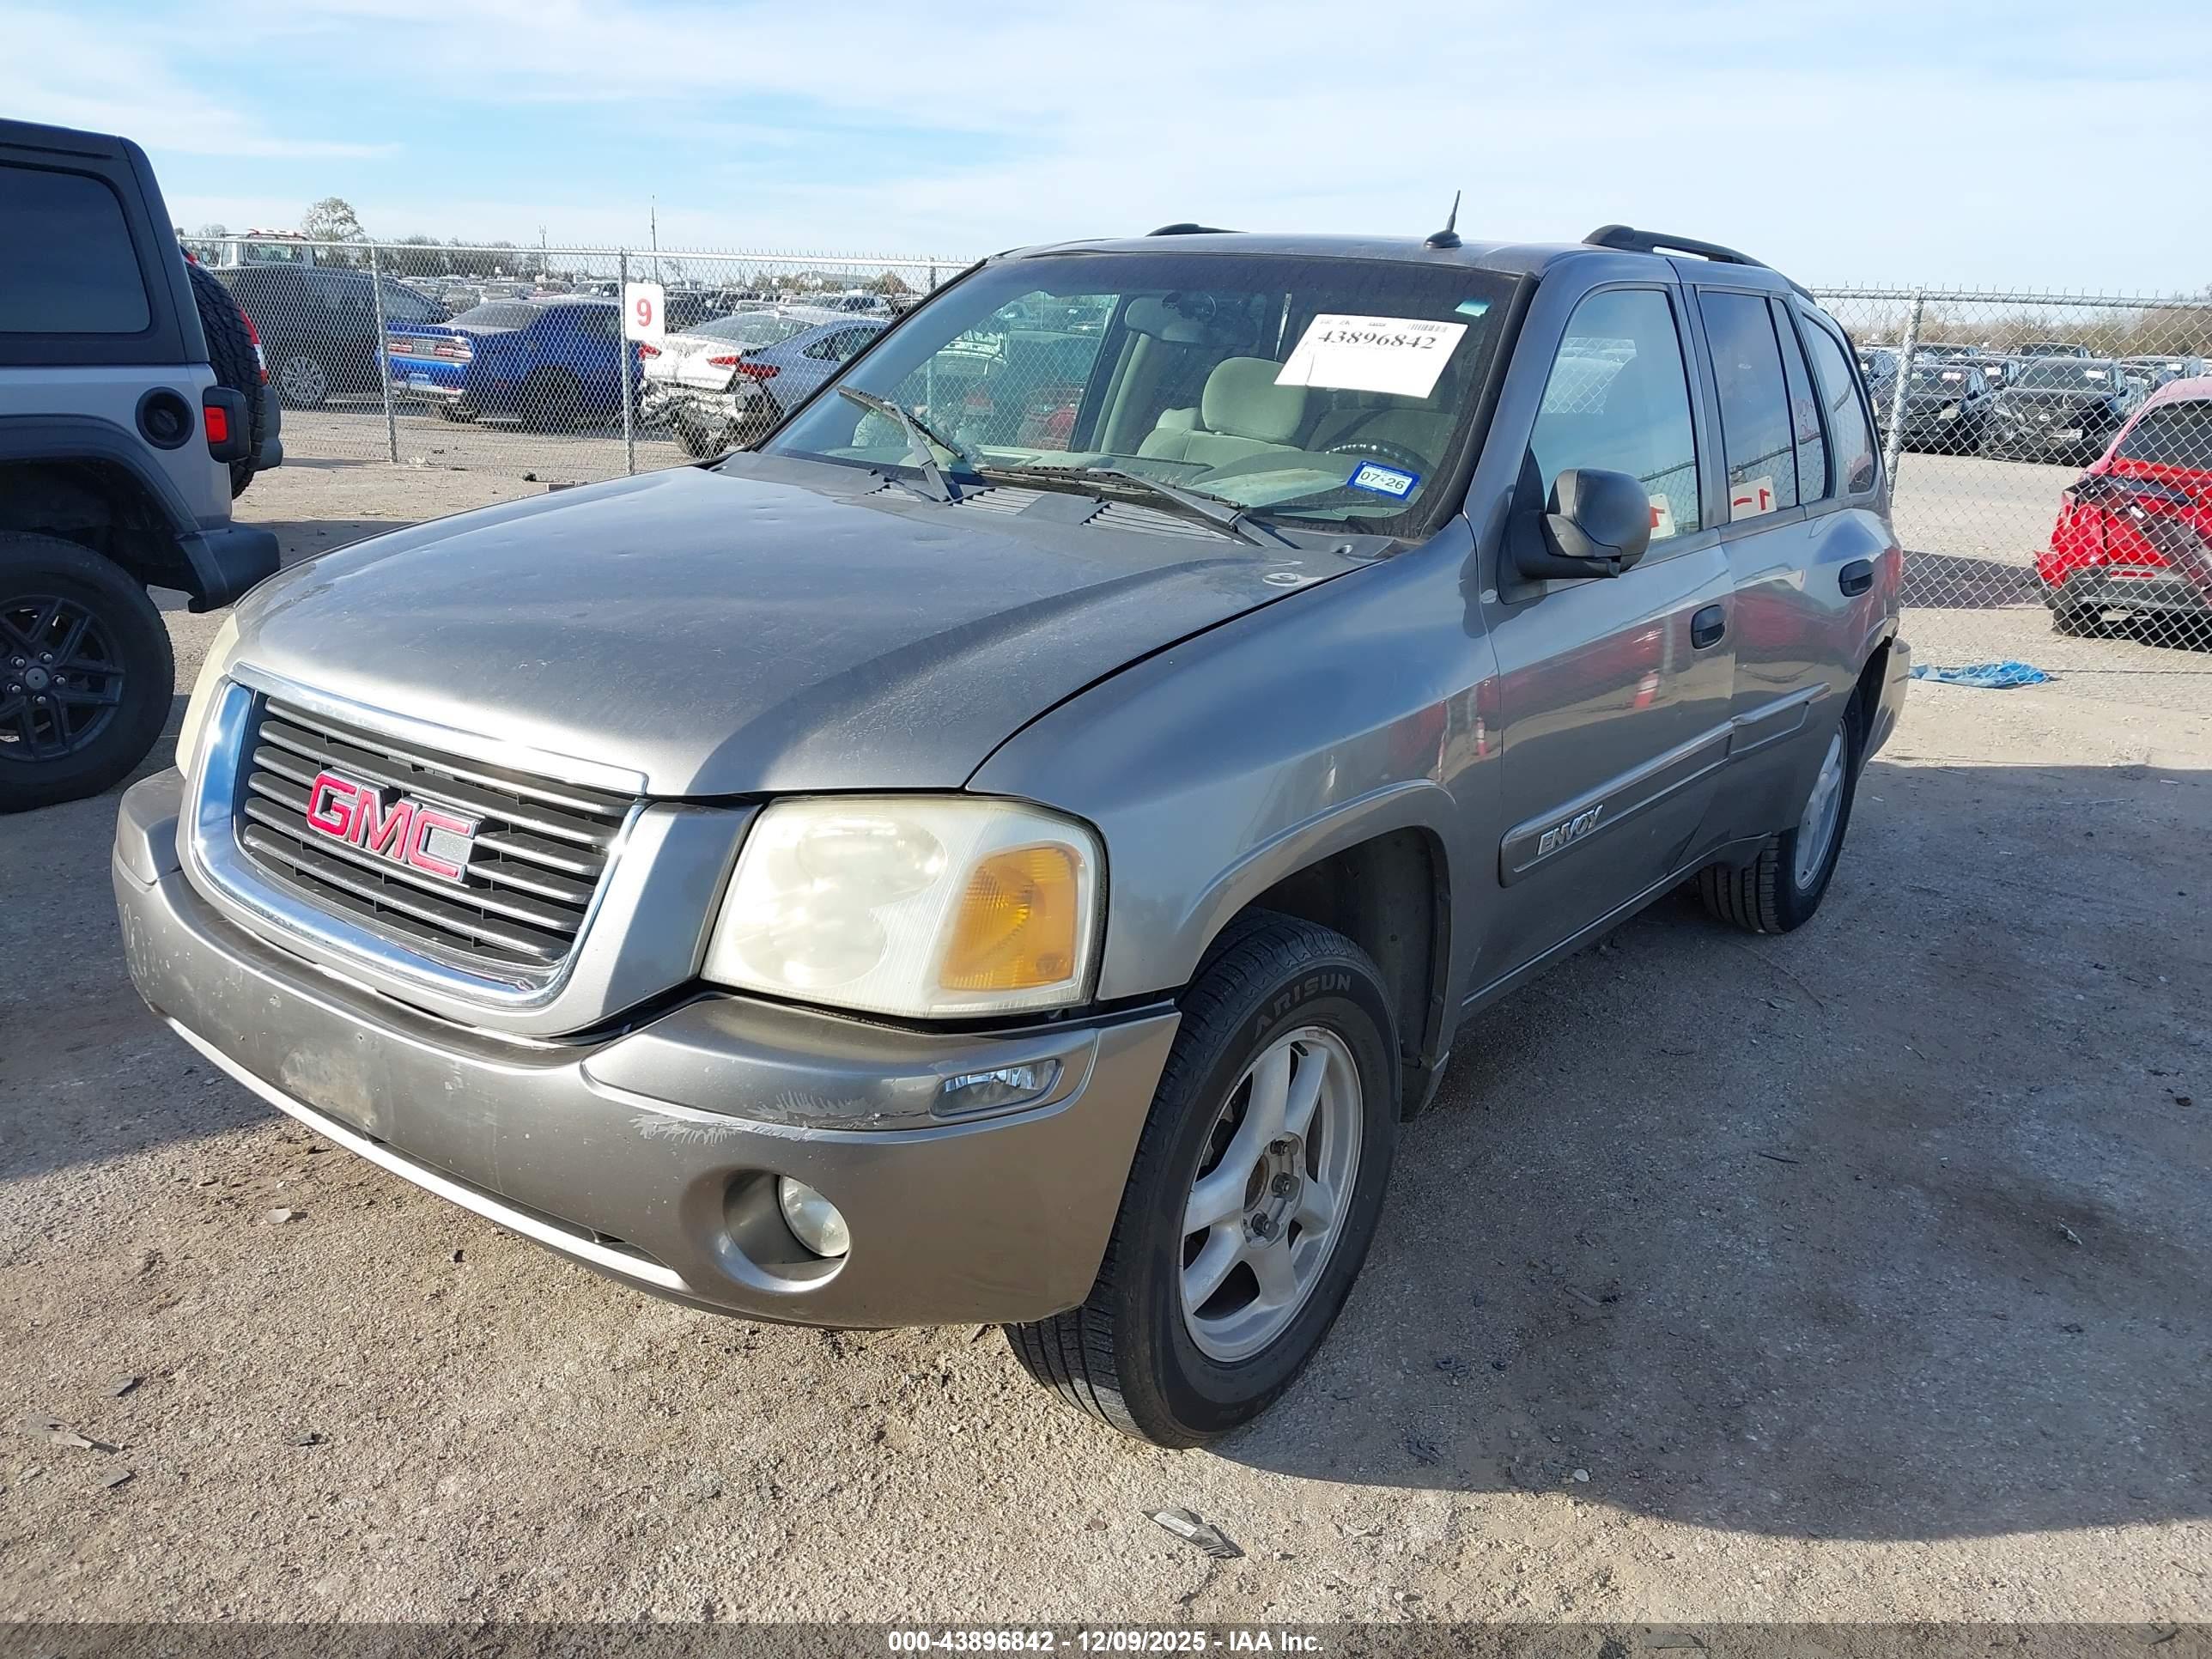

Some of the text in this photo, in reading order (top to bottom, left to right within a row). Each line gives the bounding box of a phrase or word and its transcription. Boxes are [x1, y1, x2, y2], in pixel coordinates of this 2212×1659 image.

[636, 298, 653, 327] 9
[1317, 329, 1437, 349] 43896842
[1360, 471, 1381, 483] 07
[1384, 477, 1406, 489] 26
[307, 769, 479, 883] GMC
[1537, 803, 1604, 856] ENVOY
[1254, 973, 1352, 1039] ARISUN
